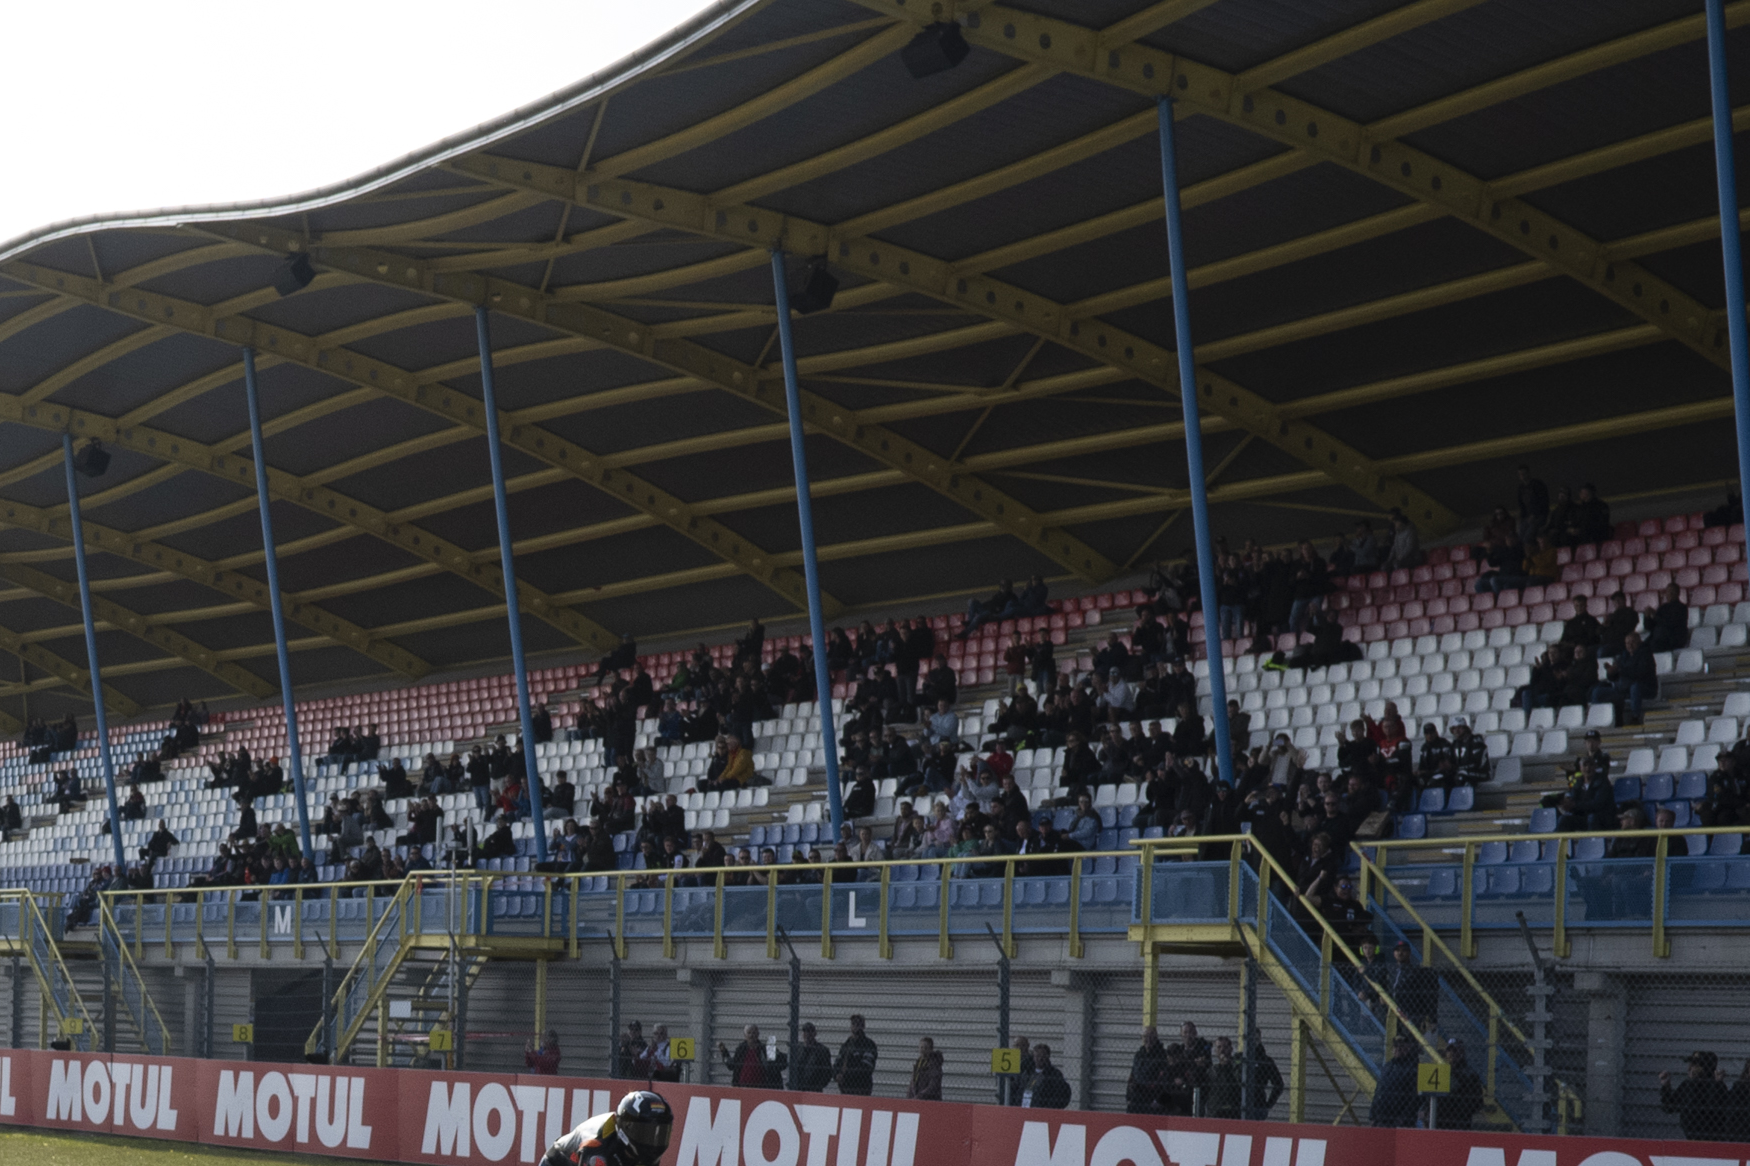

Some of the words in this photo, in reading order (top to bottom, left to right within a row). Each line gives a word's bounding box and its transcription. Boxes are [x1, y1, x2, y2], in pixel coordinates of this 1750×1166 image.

[274, 905, 291, 933] M
[849, 891, 866, 927] L
[68, 1020, 77, 1033] 9
[238, 1026, 248, 1041] 8
[437, 1033, 446, 1049] 7
[676, 1040, 688, 1058] 6
[1000, 1051, 1012, 1073] 5
[1427, 1067, 1441, 1090] 4
[46, 1059, 178, 1131] MOTUL
[214, 1070, 372, 1149] MOTUL
